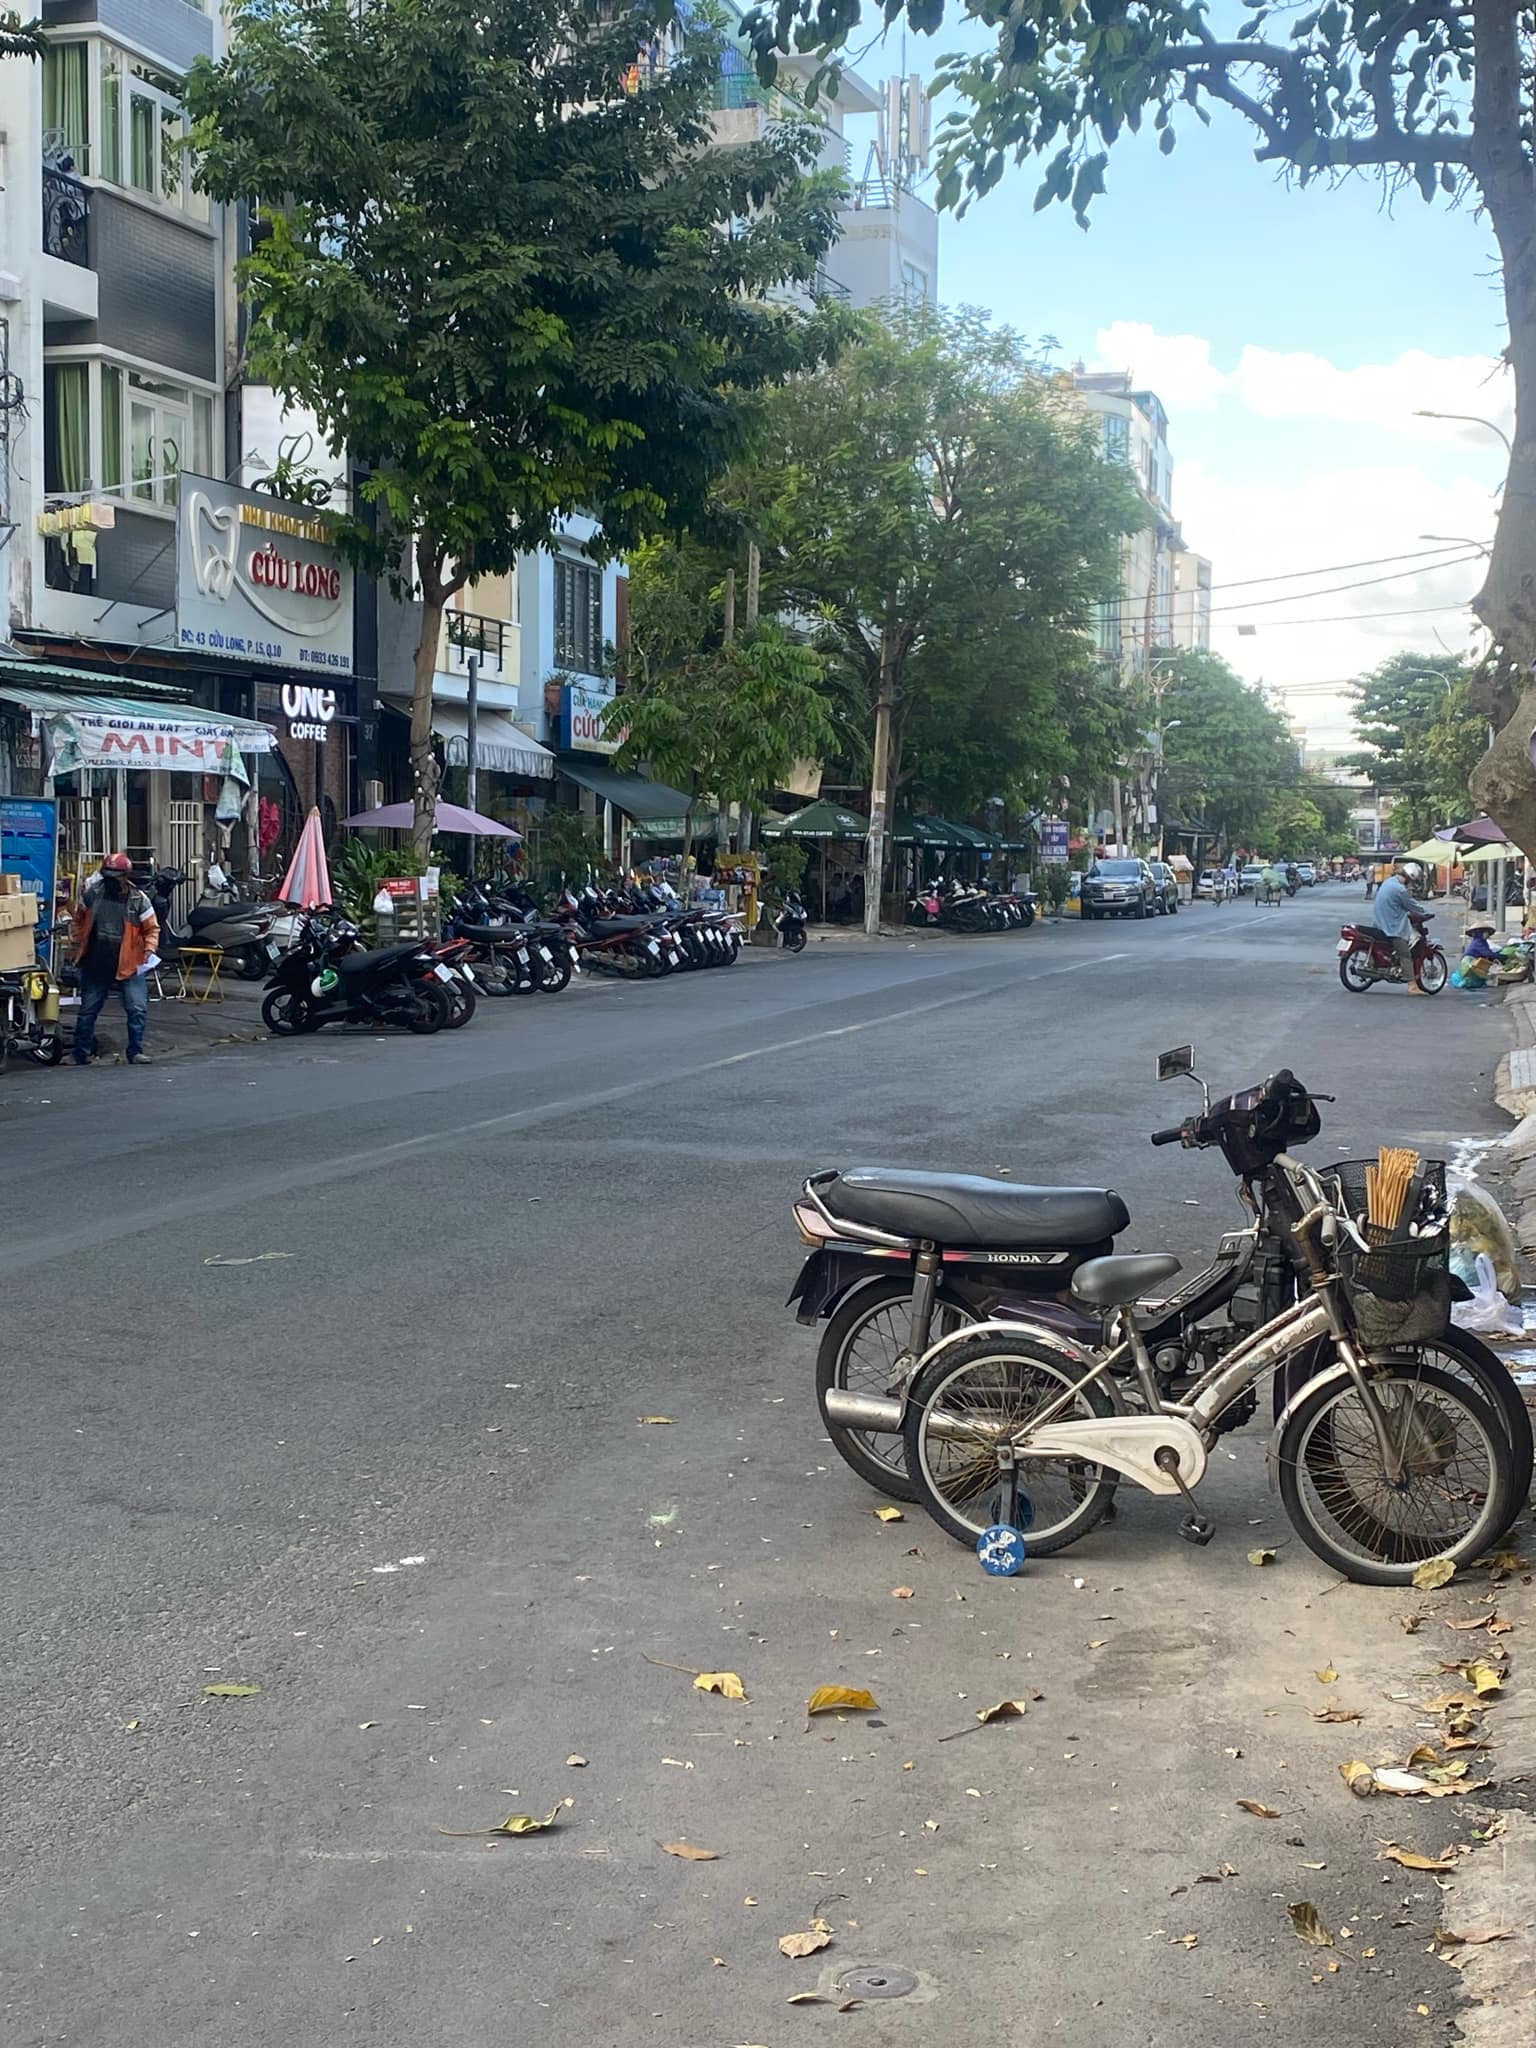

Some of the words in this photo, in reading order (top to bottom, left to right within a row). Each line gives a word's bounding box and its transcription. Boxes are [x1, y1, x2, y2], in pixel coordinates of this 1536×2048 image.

[239, 504, 265, 529] NHA
[265, 511, 297, 537] KHOA
[249, 542, 290, 589] CỬU
[291, 561, 340, 600] LONG
[196, 631, 206, 646] 43
[290, 721, 328, 742] COFFEE
[101, 732, 231, 760] MINT
[988, 1254, 1041, 1263] HONDA
